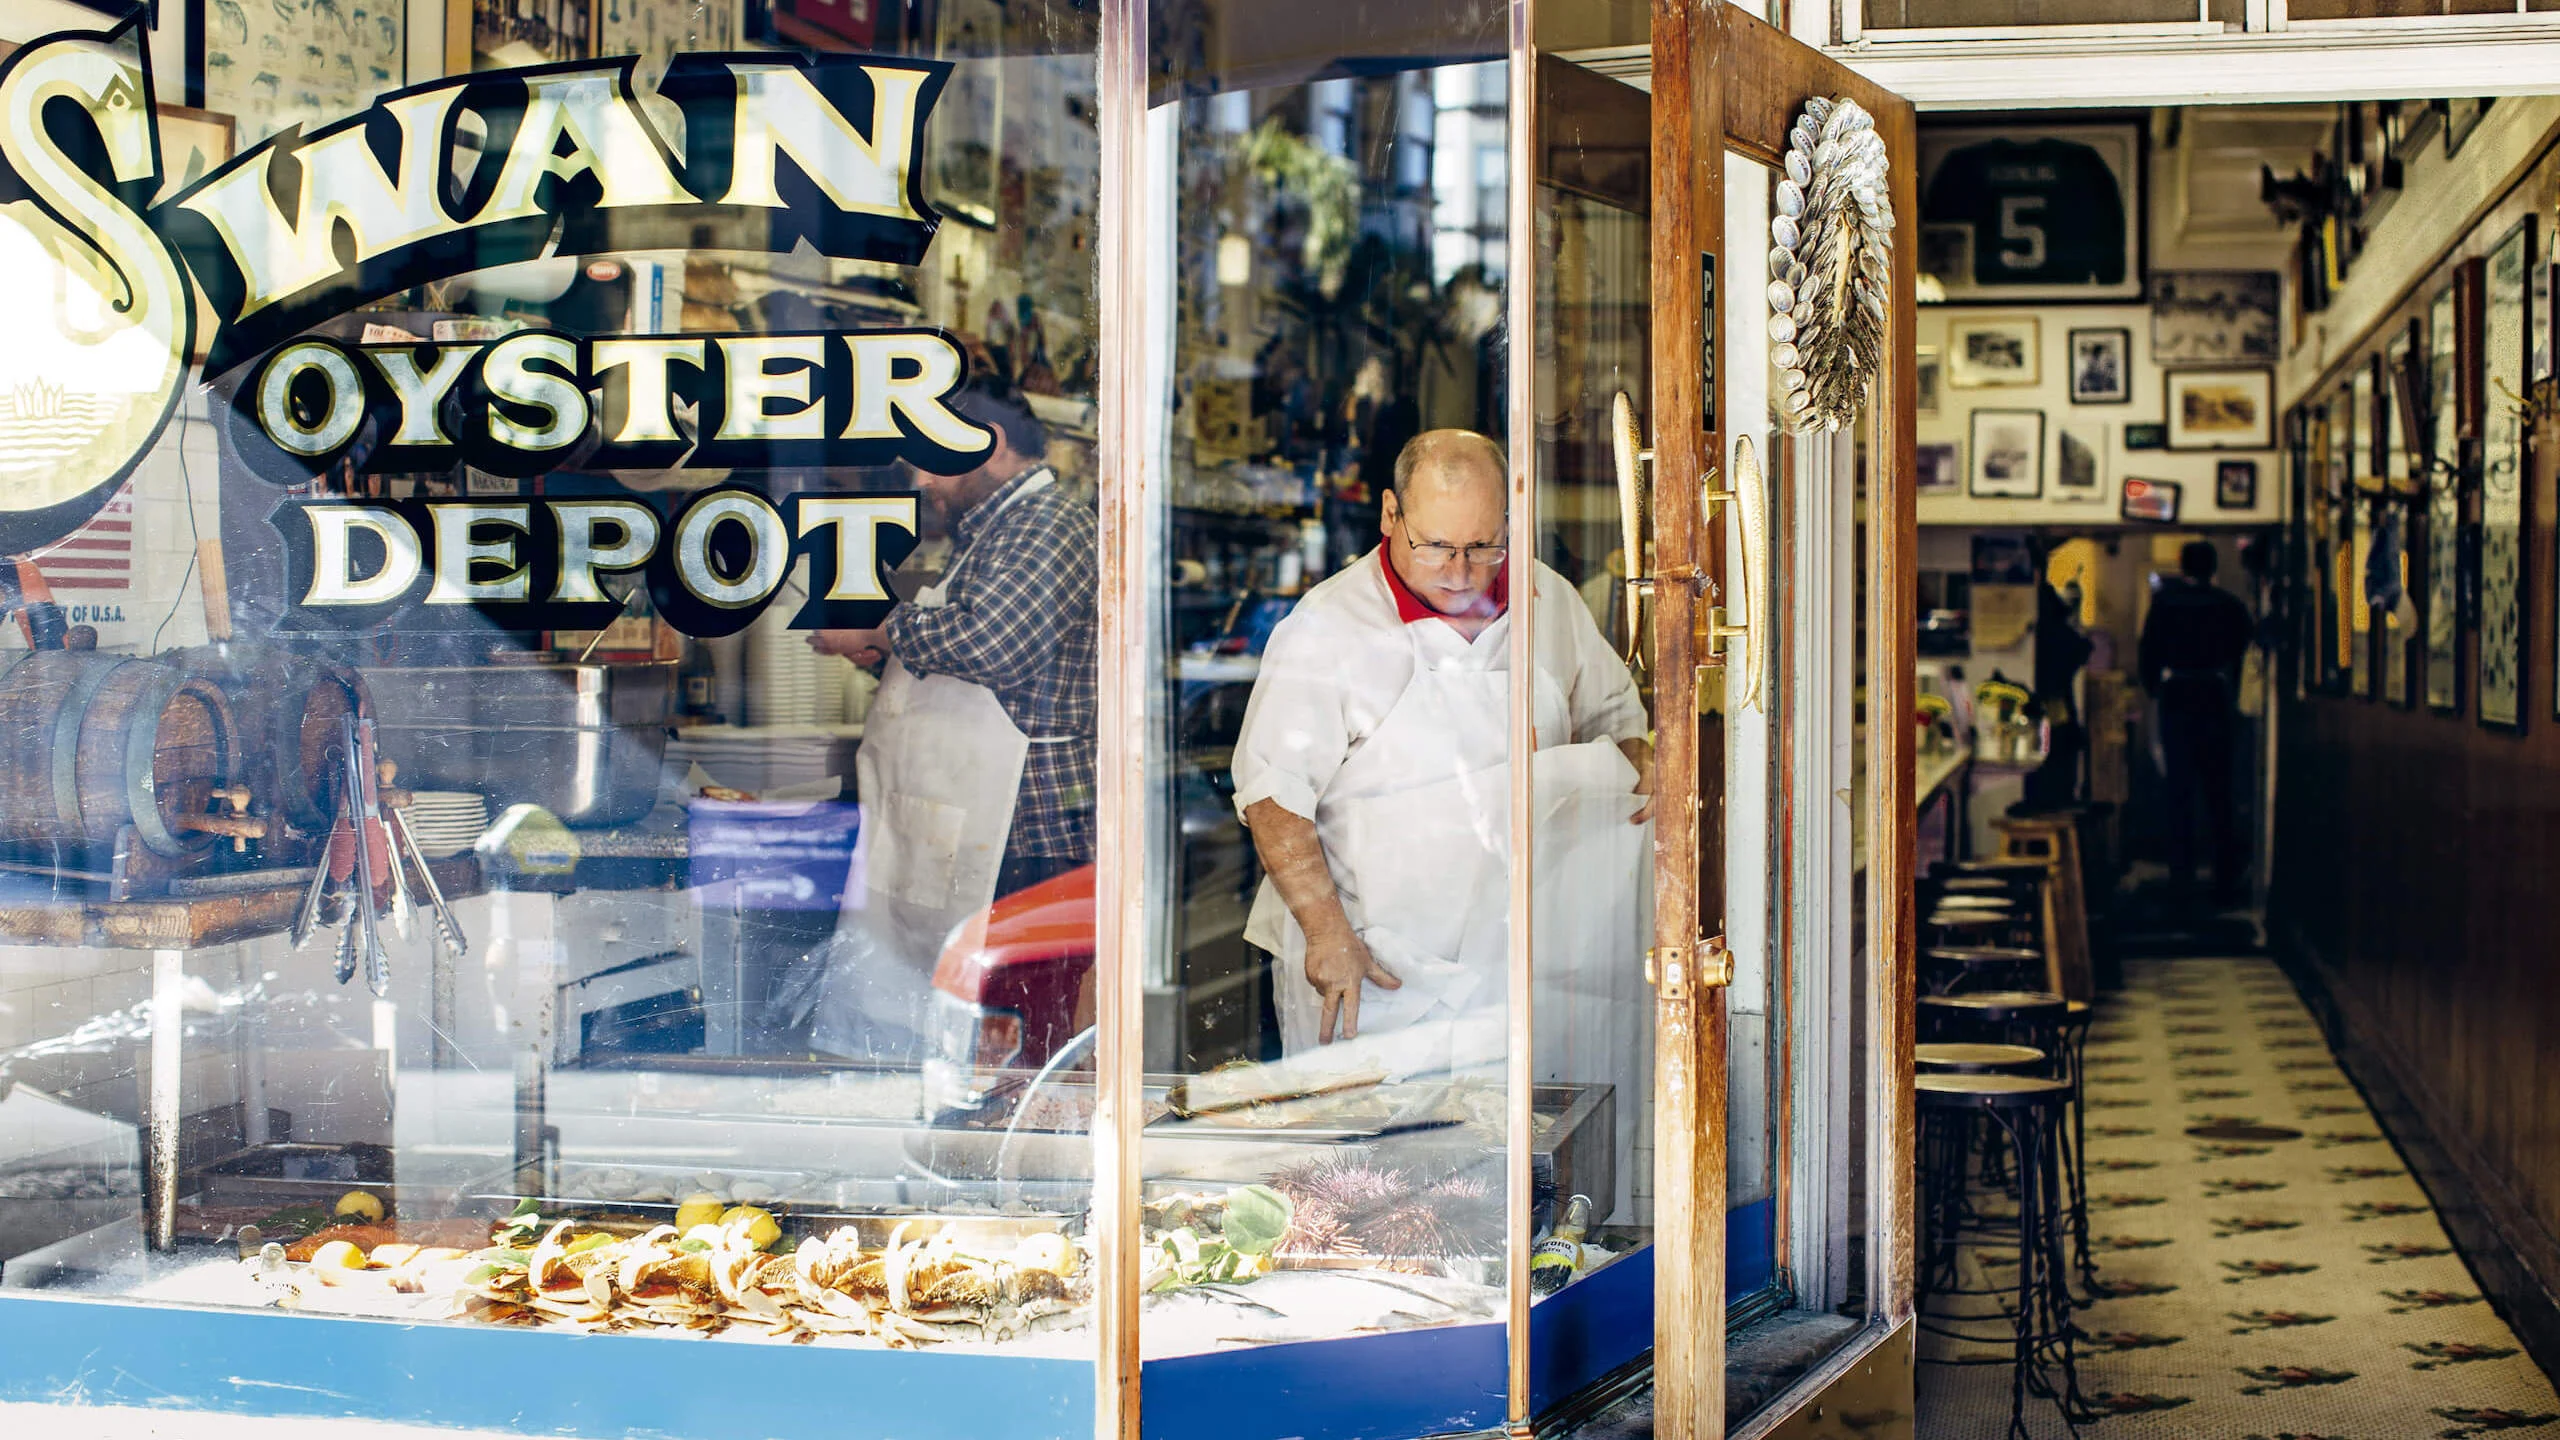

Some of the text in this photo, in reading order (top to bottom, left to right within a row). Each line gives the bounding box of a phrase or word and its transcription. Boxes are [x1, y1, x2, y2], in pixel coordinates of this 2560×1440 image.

[0, 22, 931, 510] SWAN
[2001, 197, 2047, 269] 5
[257, 334, 992, 456] OYSTER
[1703, 270, 1713, 416] PUSH
[301, 492, 917, 610] DEPOT
[71, 605, 88, 623] OF
[91, 604, 126, 623] U.S.A.
